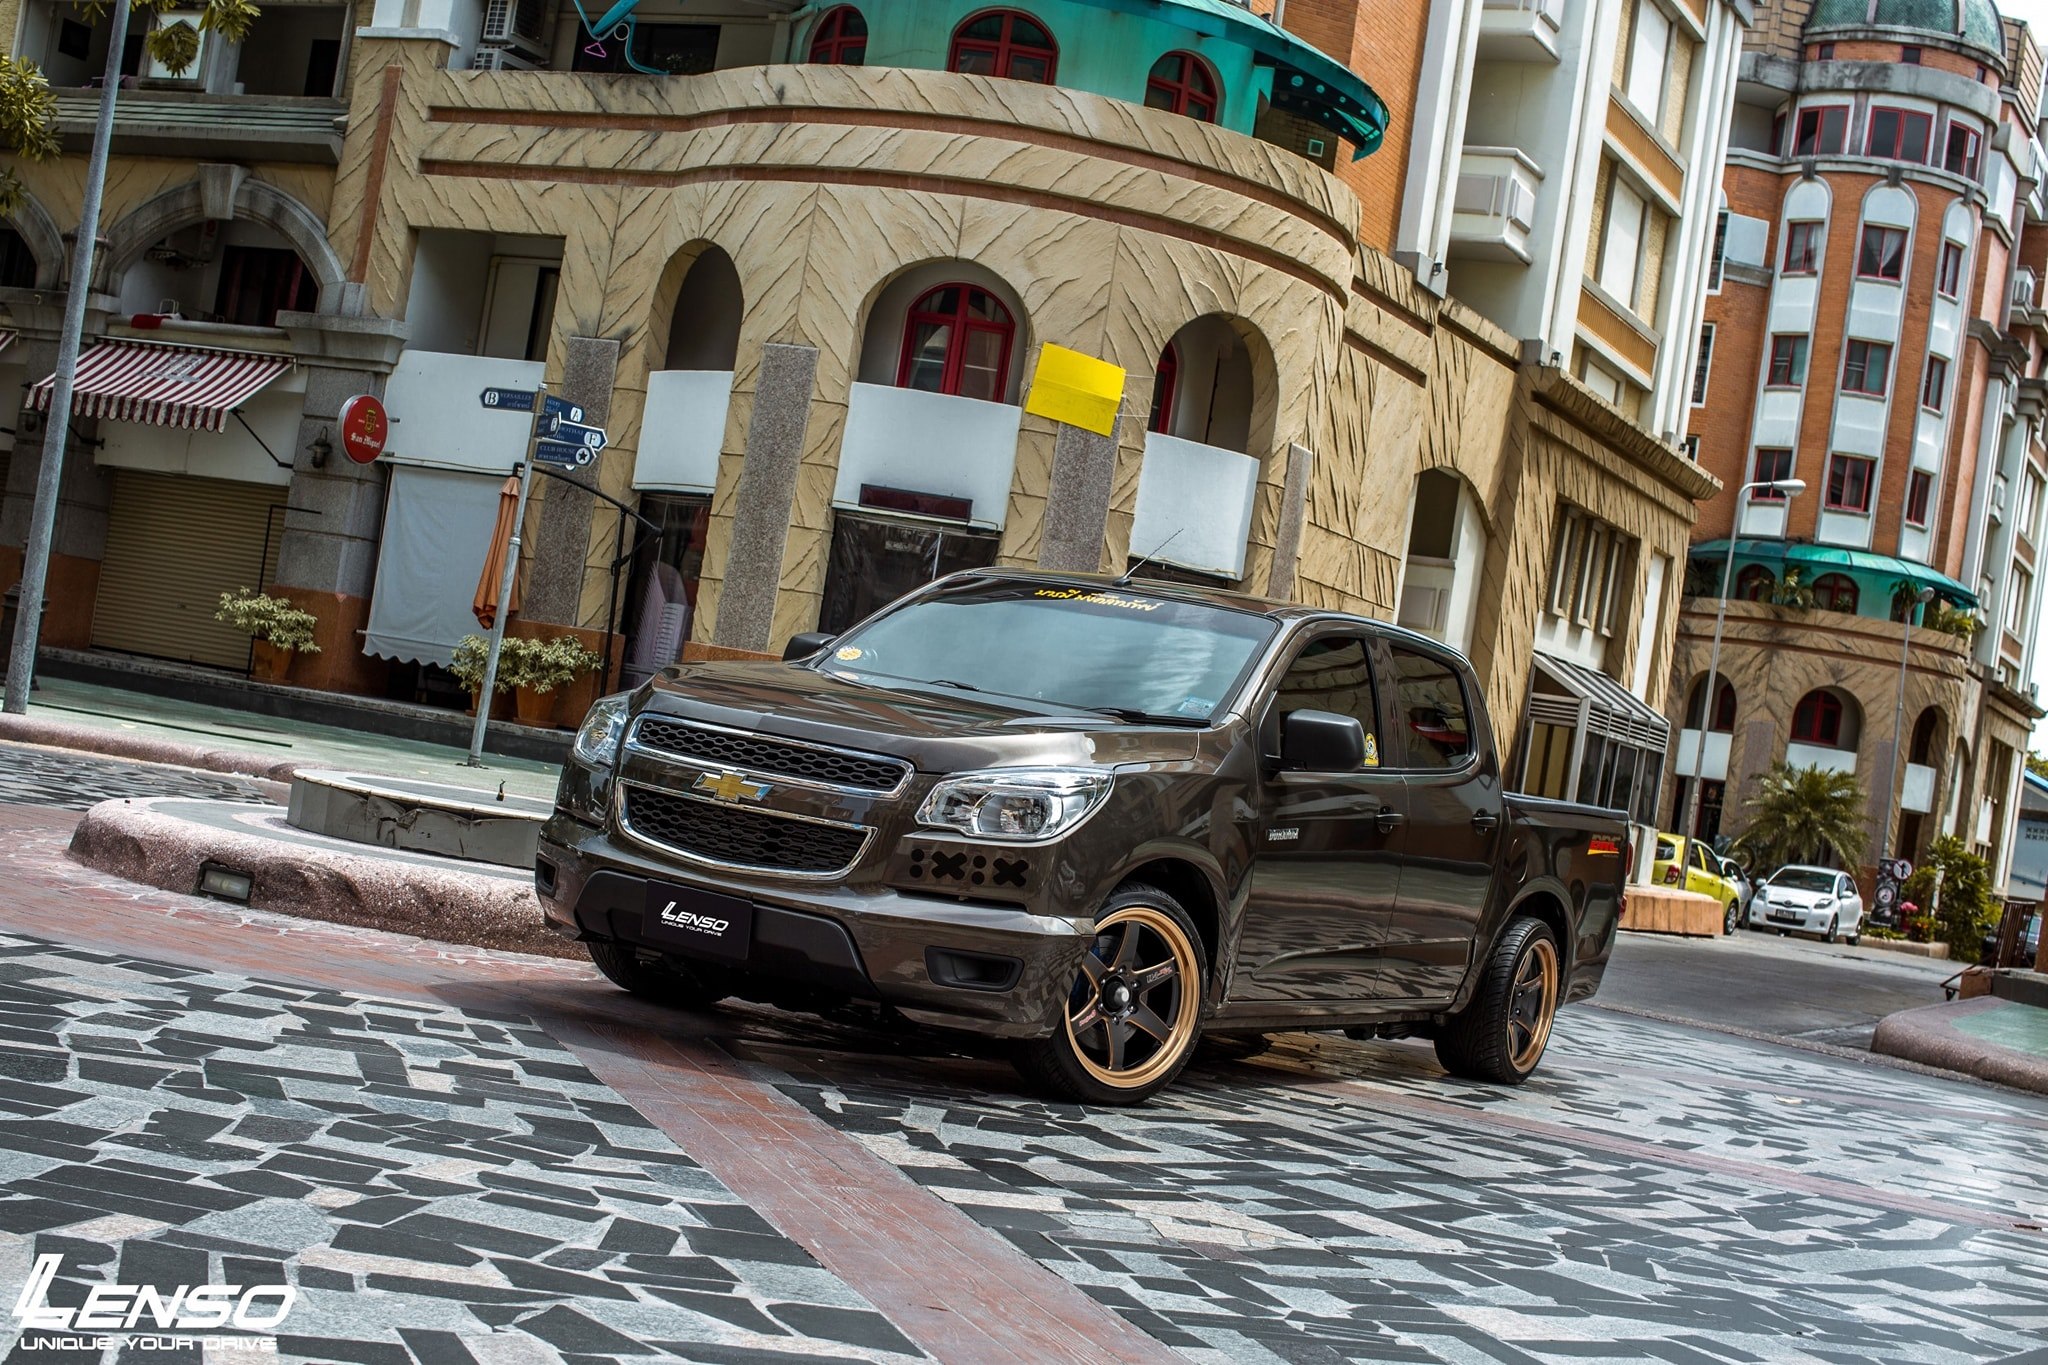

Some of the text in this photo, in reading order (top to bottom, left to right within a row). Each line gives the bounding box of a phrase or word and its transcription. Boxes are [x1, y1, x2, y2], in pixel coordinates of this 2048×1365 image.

[661, 901, 729, 932] LENSO
[661, 919, 722, 937] UNIQUE YOUR DRIVE
